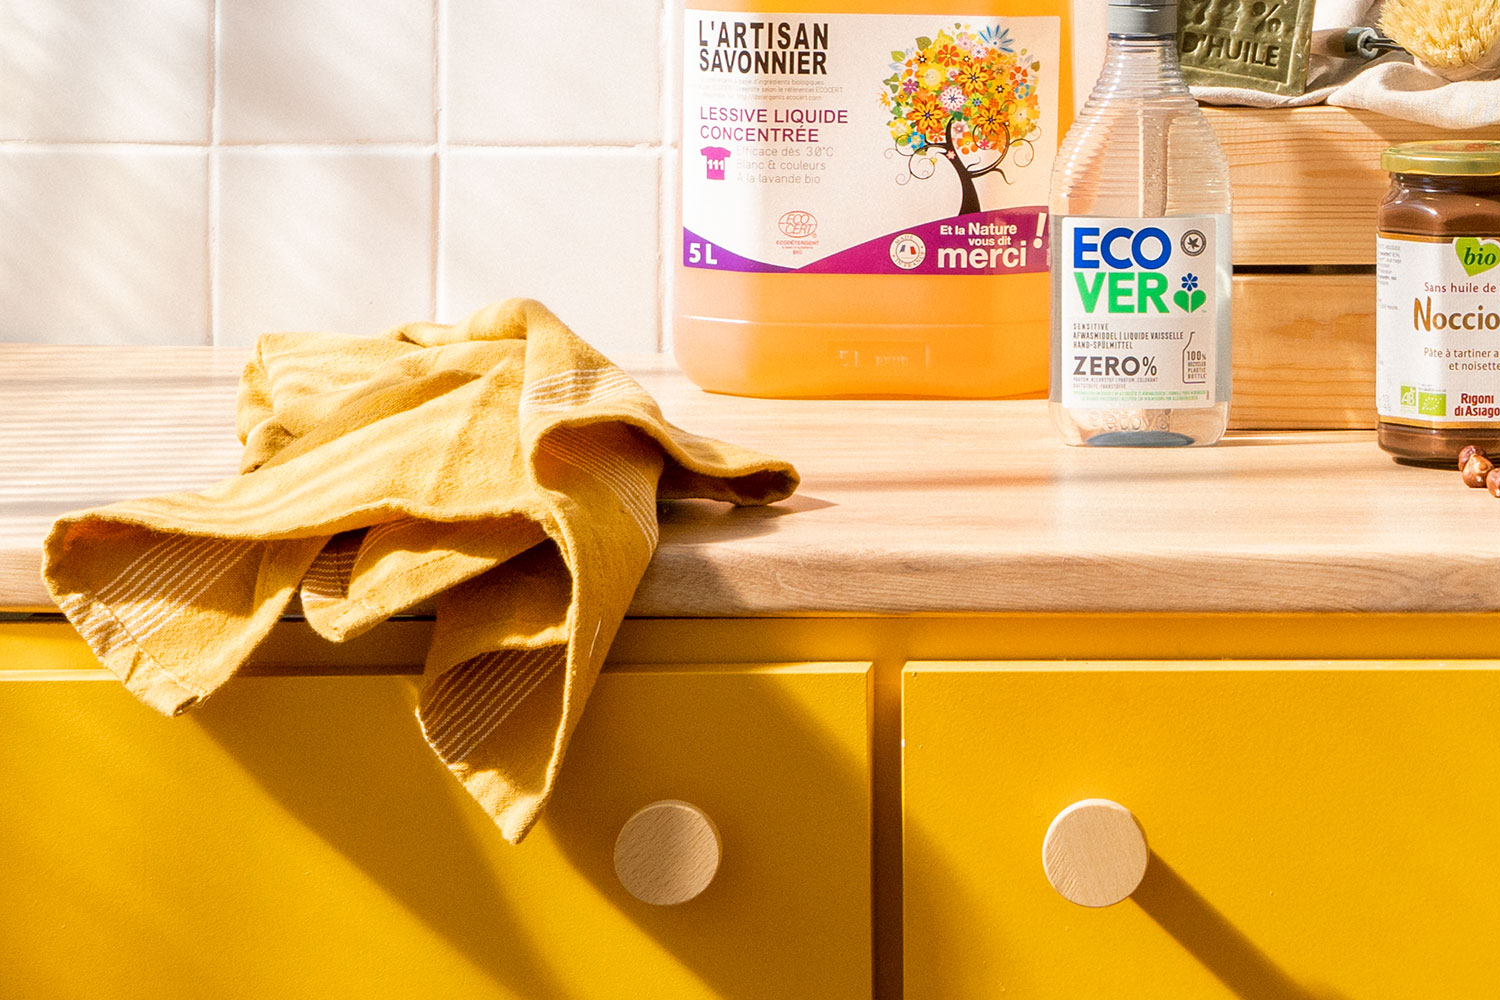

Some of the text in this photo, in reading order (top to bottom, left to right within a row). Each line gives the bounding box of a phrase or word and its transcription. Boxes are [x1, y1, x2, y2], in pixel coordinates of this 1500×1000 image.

[699, 20, 829, 50] L'ARTISAN
[699, 48, 828, 75] SAVONNIER
[700, 106, 848, 124] LESSIVE LIQUIDE
[700, 125, 819, 143] CONCENTRÉE
[767, 160, 777, 170] &
[780, 160, 827, 171] couleurs
[759, 174, 821, 184] lavande bio
[785, 213, 810, 225] ECO
[785, 223, 813, 235] CERT
[940, 222, 1017, 236] Et la Nature
[968, 236, 1012, 246] vous dit
[688, 242, 718, 265] 5 L
[938, 240, 1026, 269] merci
[1073, 227, 1172, 270] ECO
[1463, 247, 1496, 266] bio
[1073, 272, 1170, 314] VER
[1424, 282, 1447, 293] Sans
[1450, 282, 1479, 293] huile
[1483, 282, 1497, 293] de
[1073, 331, 1184, 340] AFWASMIDDEL LIQUIDE VAISSELLE
[1073, 341, 1133, 350] HAND-SPÜLMITTEL
[1424, 348, 1443, 358] Pâte
[1446, 348, 1451, 358] à
[1453, 349, 1492, 358] tartiner
[1448, 362, 1459, 371] et
[1461, 393, 1494, 405] Rigoni
[1454, 406, 1500, 418] di Asiago
